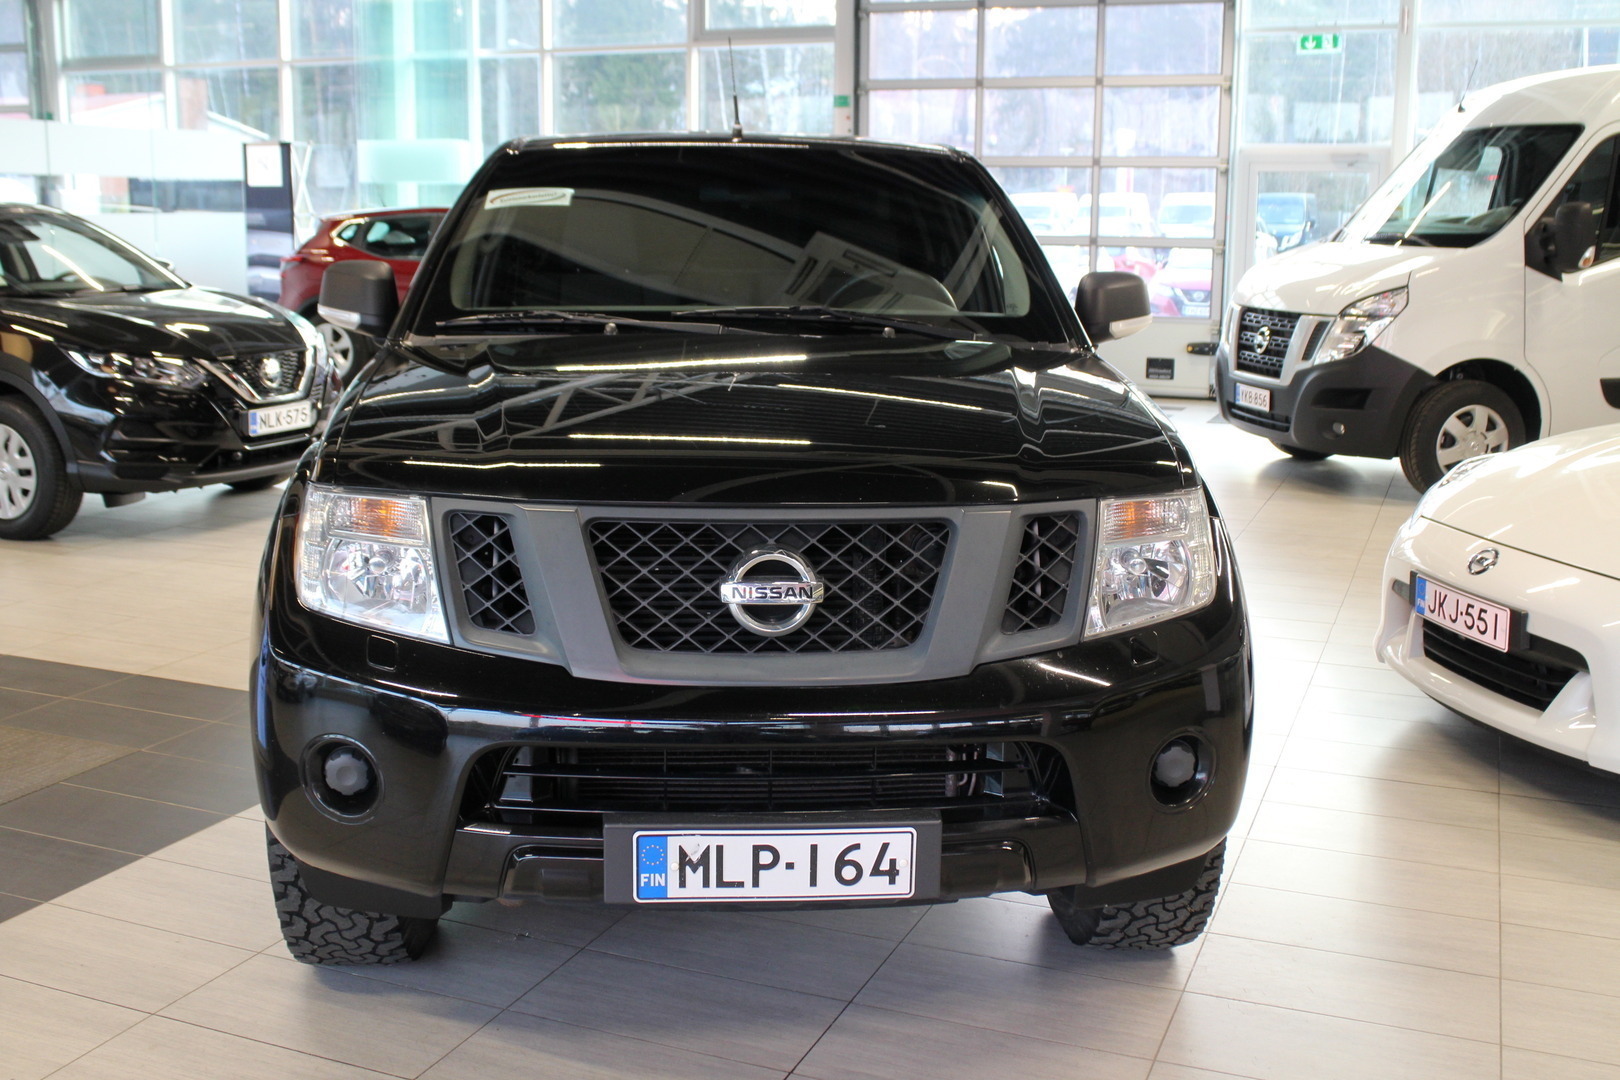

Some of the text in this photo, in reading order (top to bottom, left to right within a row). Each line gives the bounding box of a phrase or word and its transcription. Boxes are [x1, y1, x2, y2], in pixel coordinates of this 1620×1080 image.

[732, 586, 813, 599] NISSAN
[678, 842, 899, 889] MLP-164
[640, 873, 666, 887] FIN
